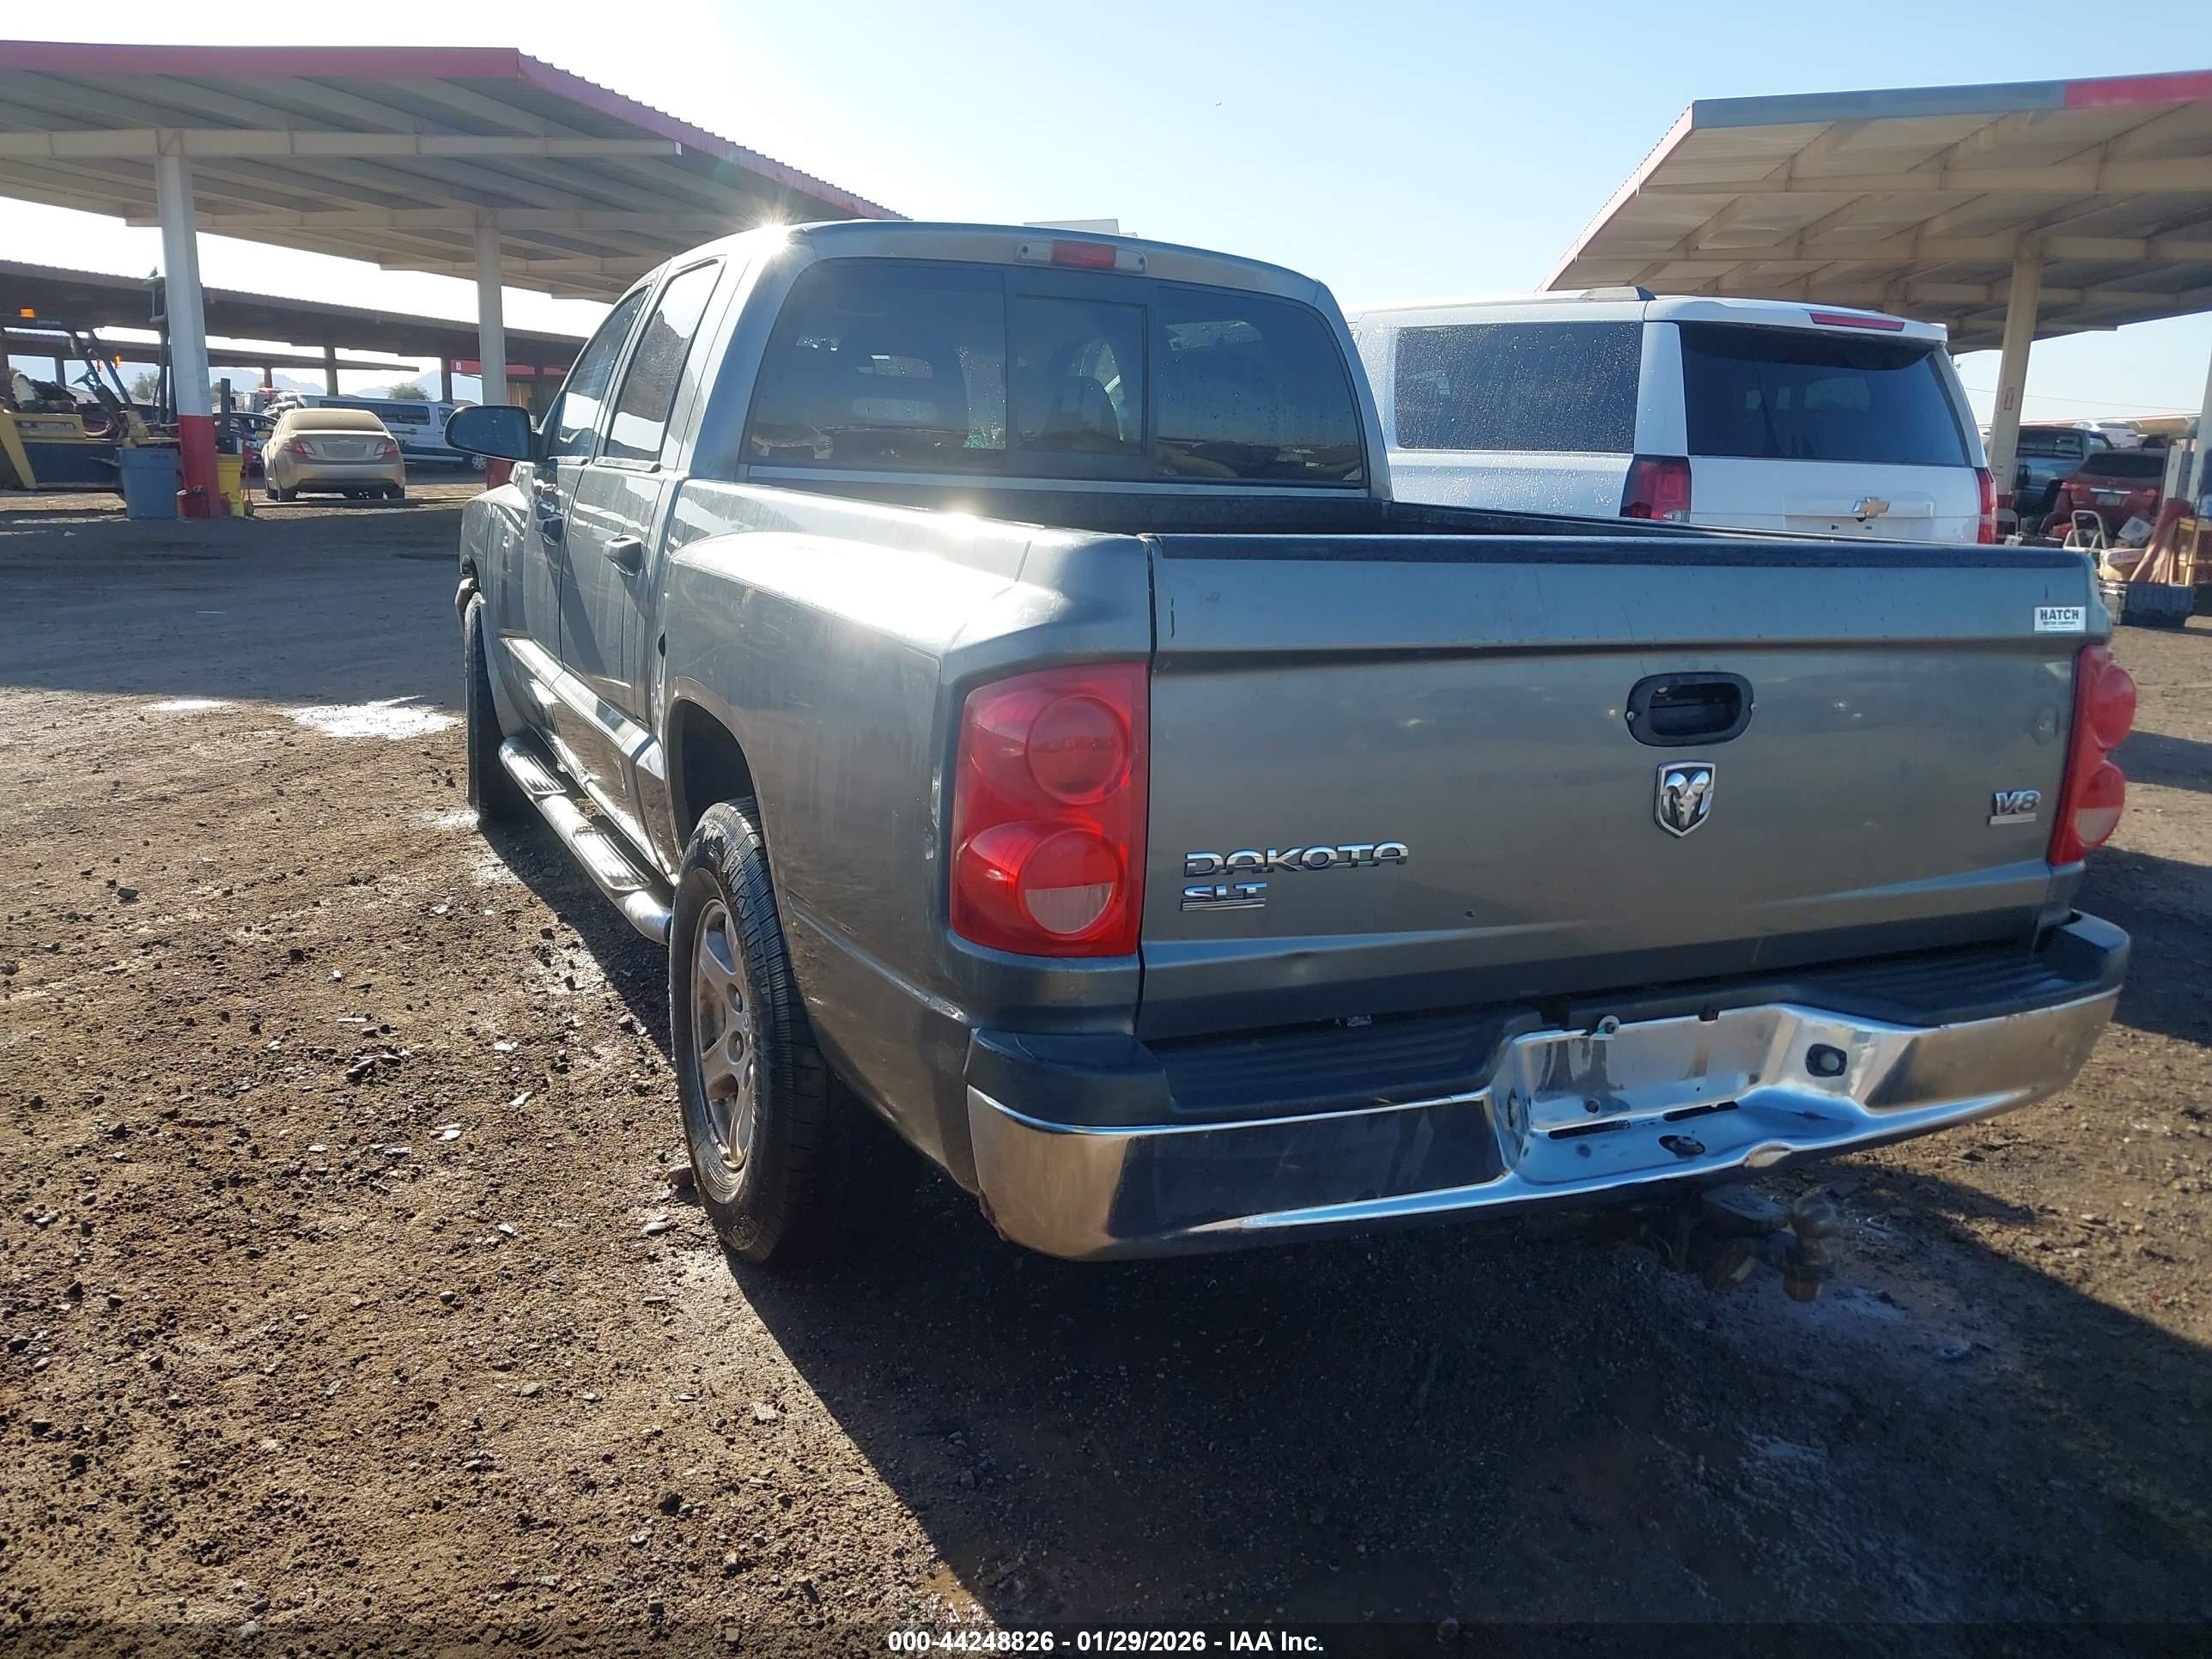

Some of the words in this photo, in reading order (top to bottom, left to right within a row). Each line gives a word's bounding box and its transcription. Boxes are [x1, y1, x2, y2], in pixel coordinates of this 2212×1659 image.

[2040, 609, 2079, 620] HATCH
[1993, 790, 2041, 815] V8
[1184, 841, 1409, 877] DAKOTA
[1182, 881, 1267, 901] SLT
